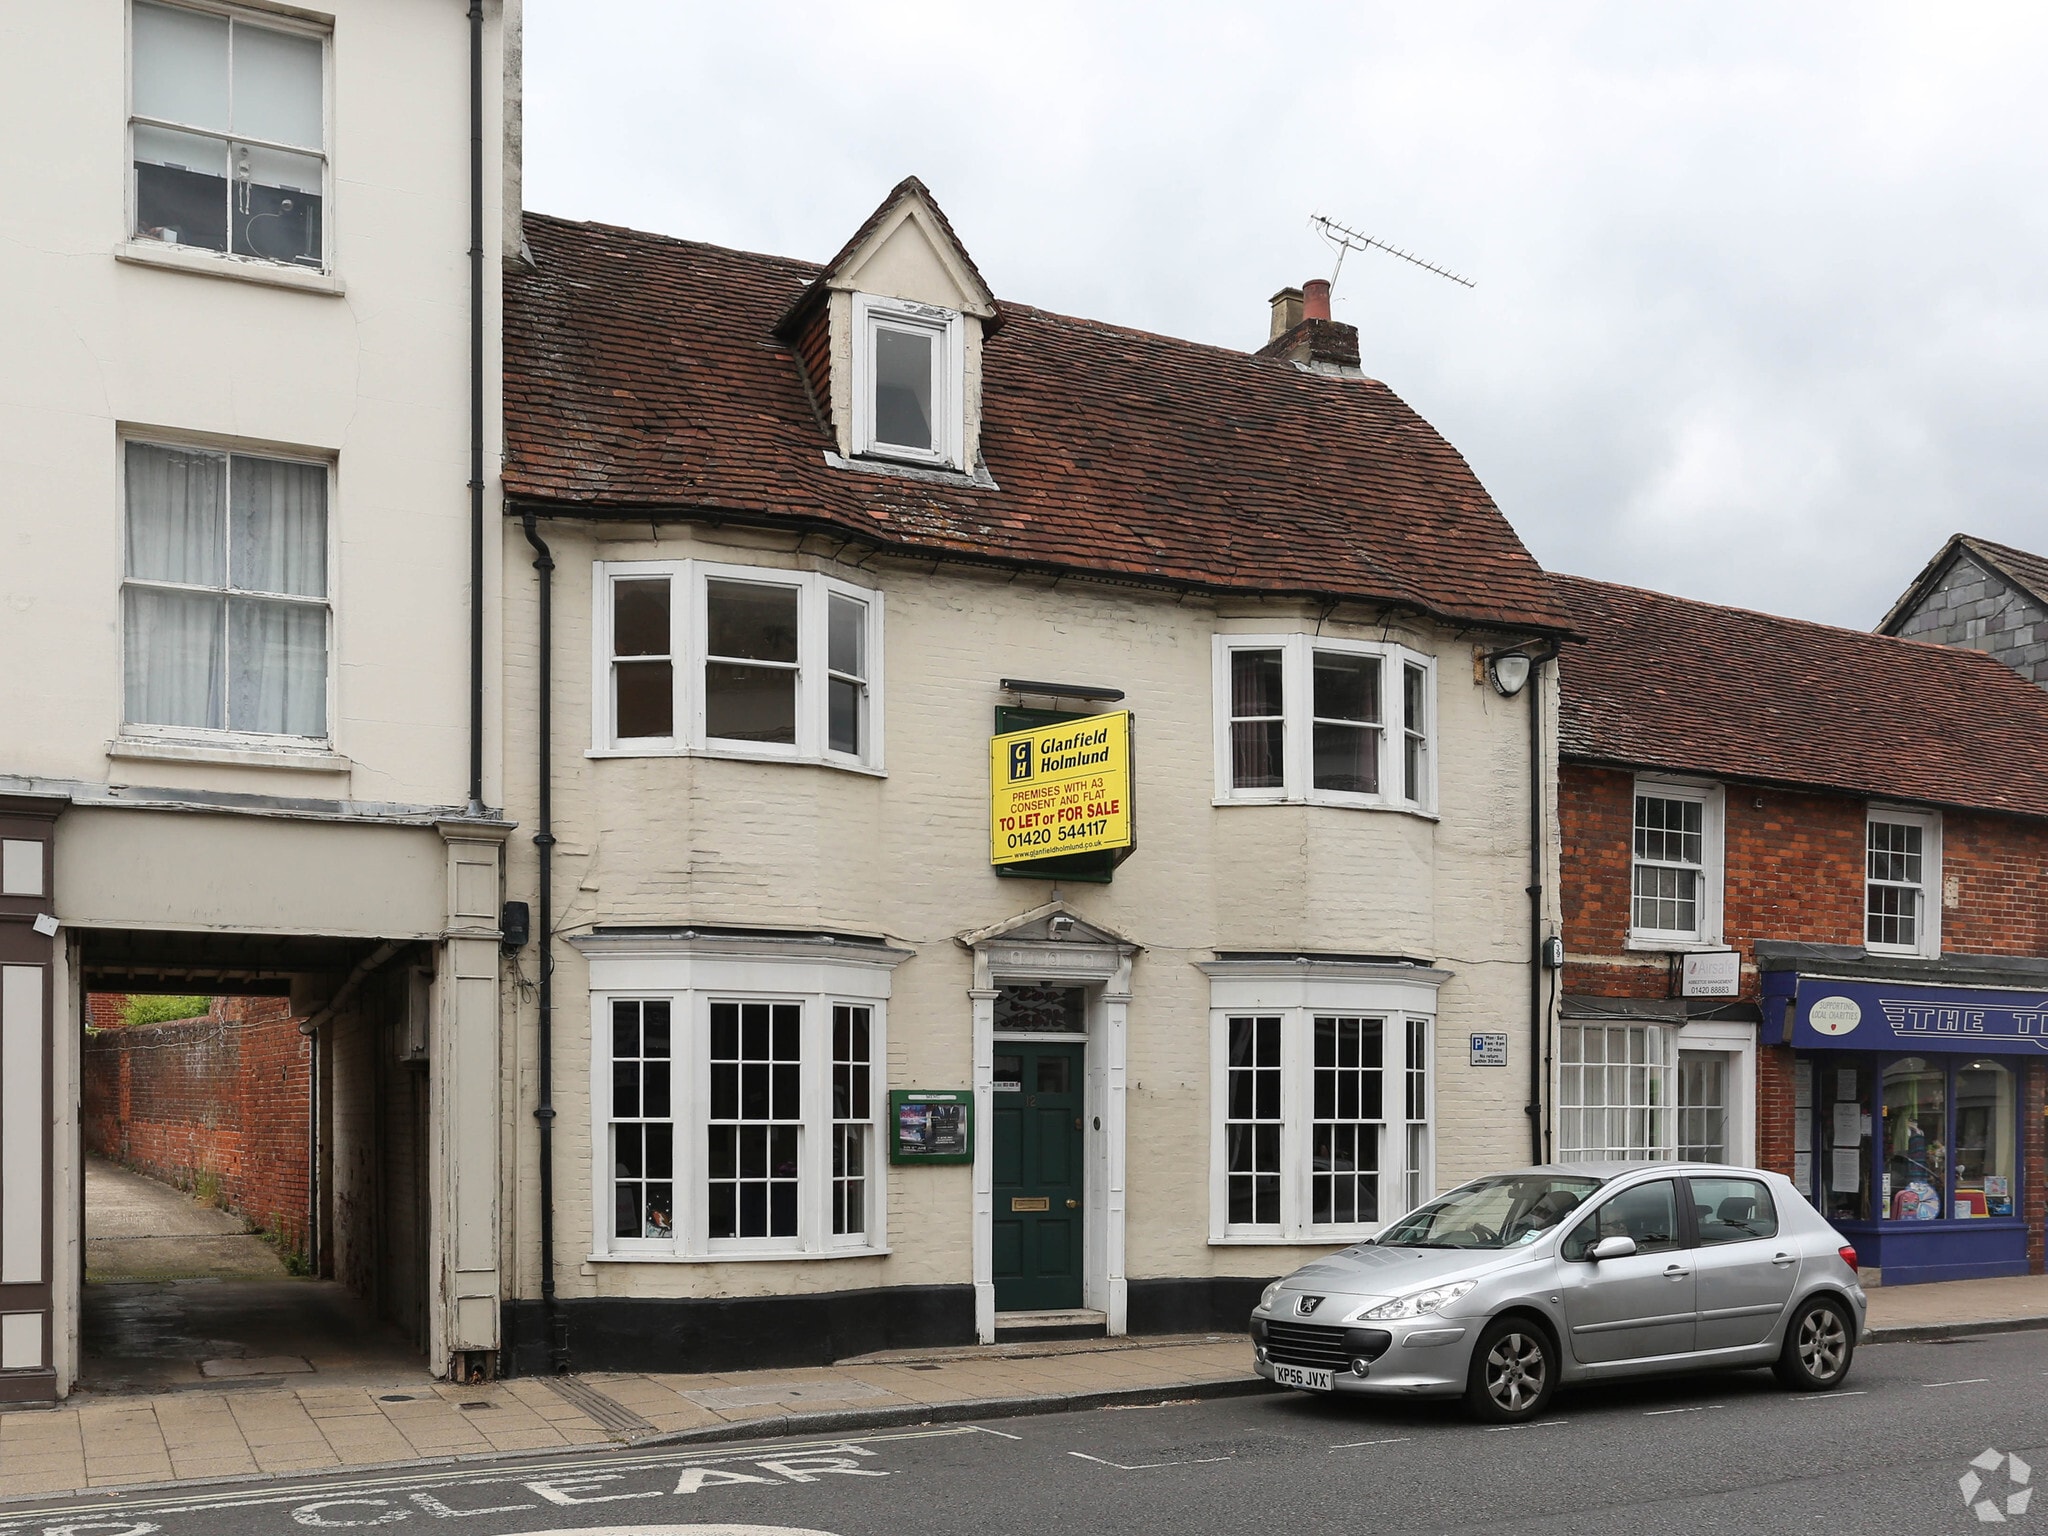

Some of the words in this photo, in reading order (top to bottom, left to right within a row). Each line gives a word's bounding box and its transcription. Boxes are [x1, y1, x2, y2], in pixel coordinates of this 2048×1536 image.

[1015, 744, 1026, 760] G
[1041, 728, 1108, 755] Glanfield
[1015, 761, 1027, 778] H
[1041, 746, 1109, 773] Holmlund
[1010, 798, 1056, 814] CONSENT
[1060, 794, 1079, 806] AND
[1083, 789, 1106, 801] FLAT
[1012, 786, 1060, 802] PREMISES
[1064, 780, 1087, 794] WITH
[1091, 778, 1104, 789] A3
[999, 817, 1015, 831] TO
[1019, 813, 1041, 829] LET
[1042, 815, 1055, 825] or
[1058, 806, 1083, 822] FOR
[1087, 800, 1119, 818] SALE
[1007, 829, 1051, 848] 01420
[1058, 820, 1107, 841] 544117
[1014, 841, 1102, 858] www.glanfieldholmlund.co.uk
[1698, 961, 1735, 975] Airsafe
[1691, 986, 1710, 994] 01420
[1811, 1010, 1827, 1019] LOCAL
[1829, 1011, 1858, 1020] CHARITIES
[1819, 1001, 1854, 1010] SUPPORTING
[1908, 1008, 1985, 1032] THE
[1278, 1366, 1303, 1384] KP56
[1306, 1371, 1327, 1388] JVX
[291, 1457, 889, 1528] CLEAR
